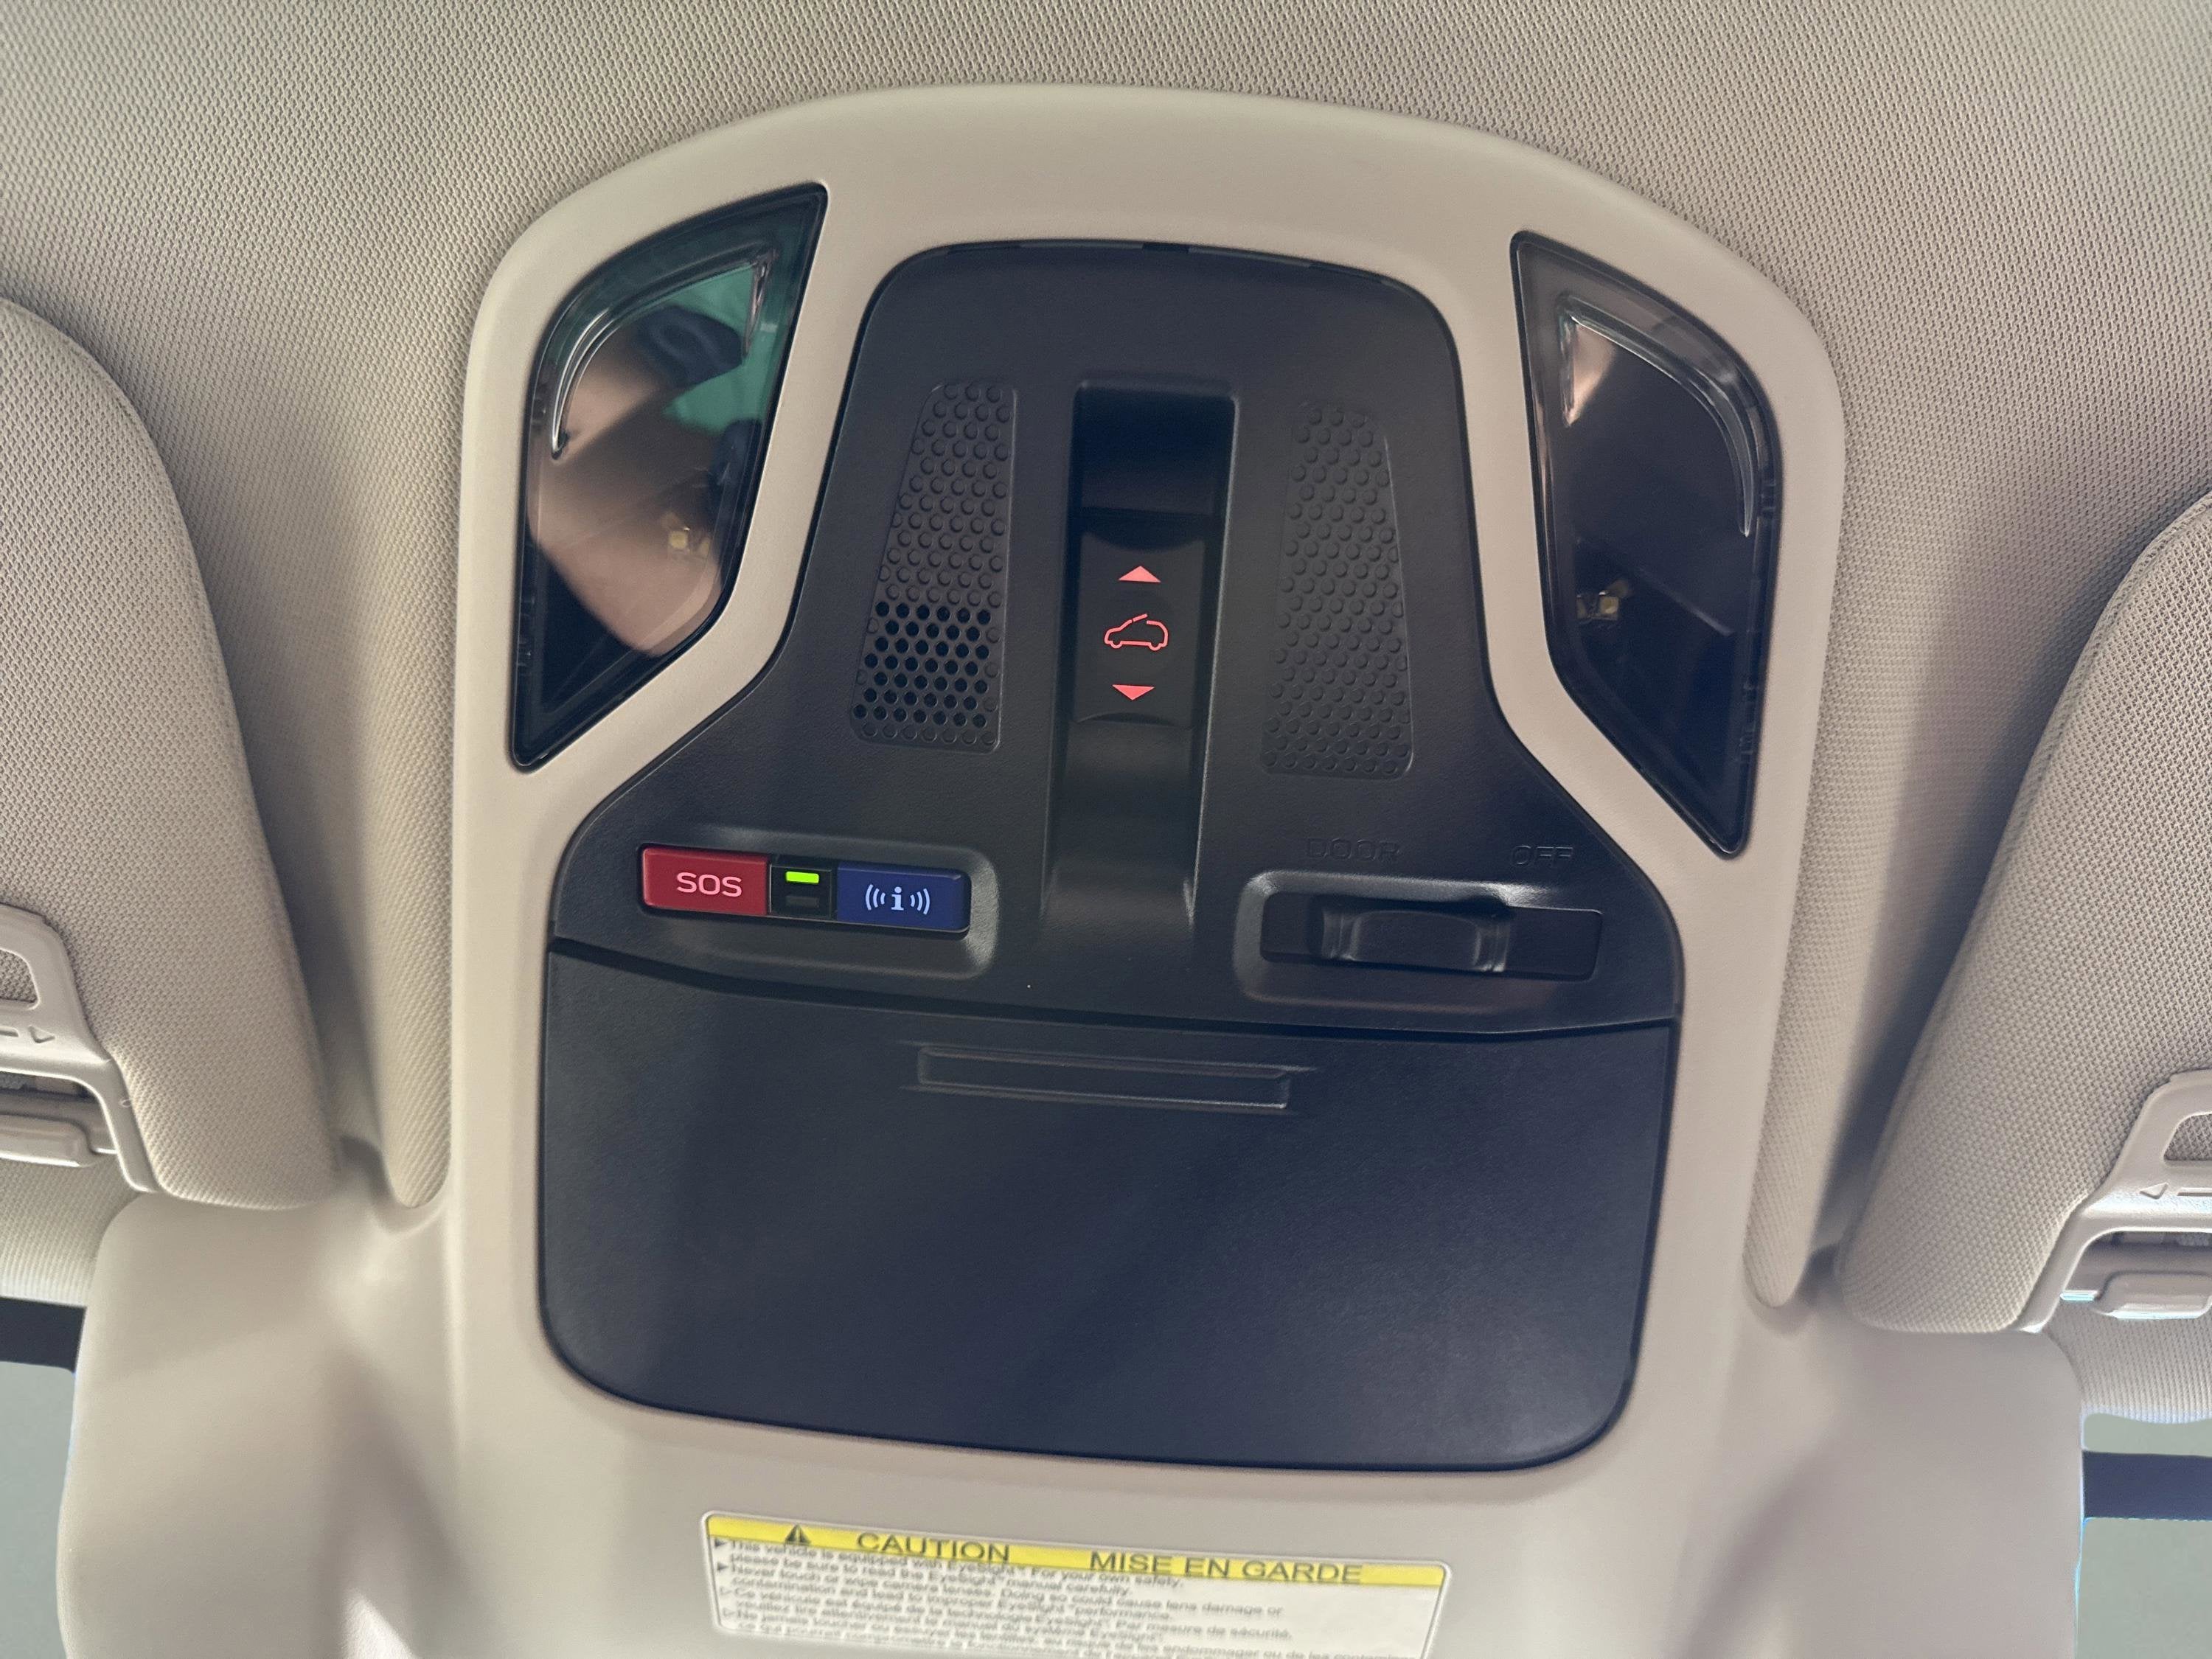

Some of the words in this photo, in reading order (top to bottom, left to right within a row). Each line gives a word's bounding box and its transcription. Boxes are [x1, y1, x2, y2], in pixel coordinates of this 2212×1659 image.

[1307, 838, 1400, 863] DOOR
[1512, 845, 1574, 867] OFF
[676, 871, 743, 897] SOS
[857, 1531, 1009, 1562] CAUTION
[1090, 1551, 1172, 1574] MISE
[1184, 1557, 1230, 1578] EN
[1242, 1560, 1363, 1584] GARDE
